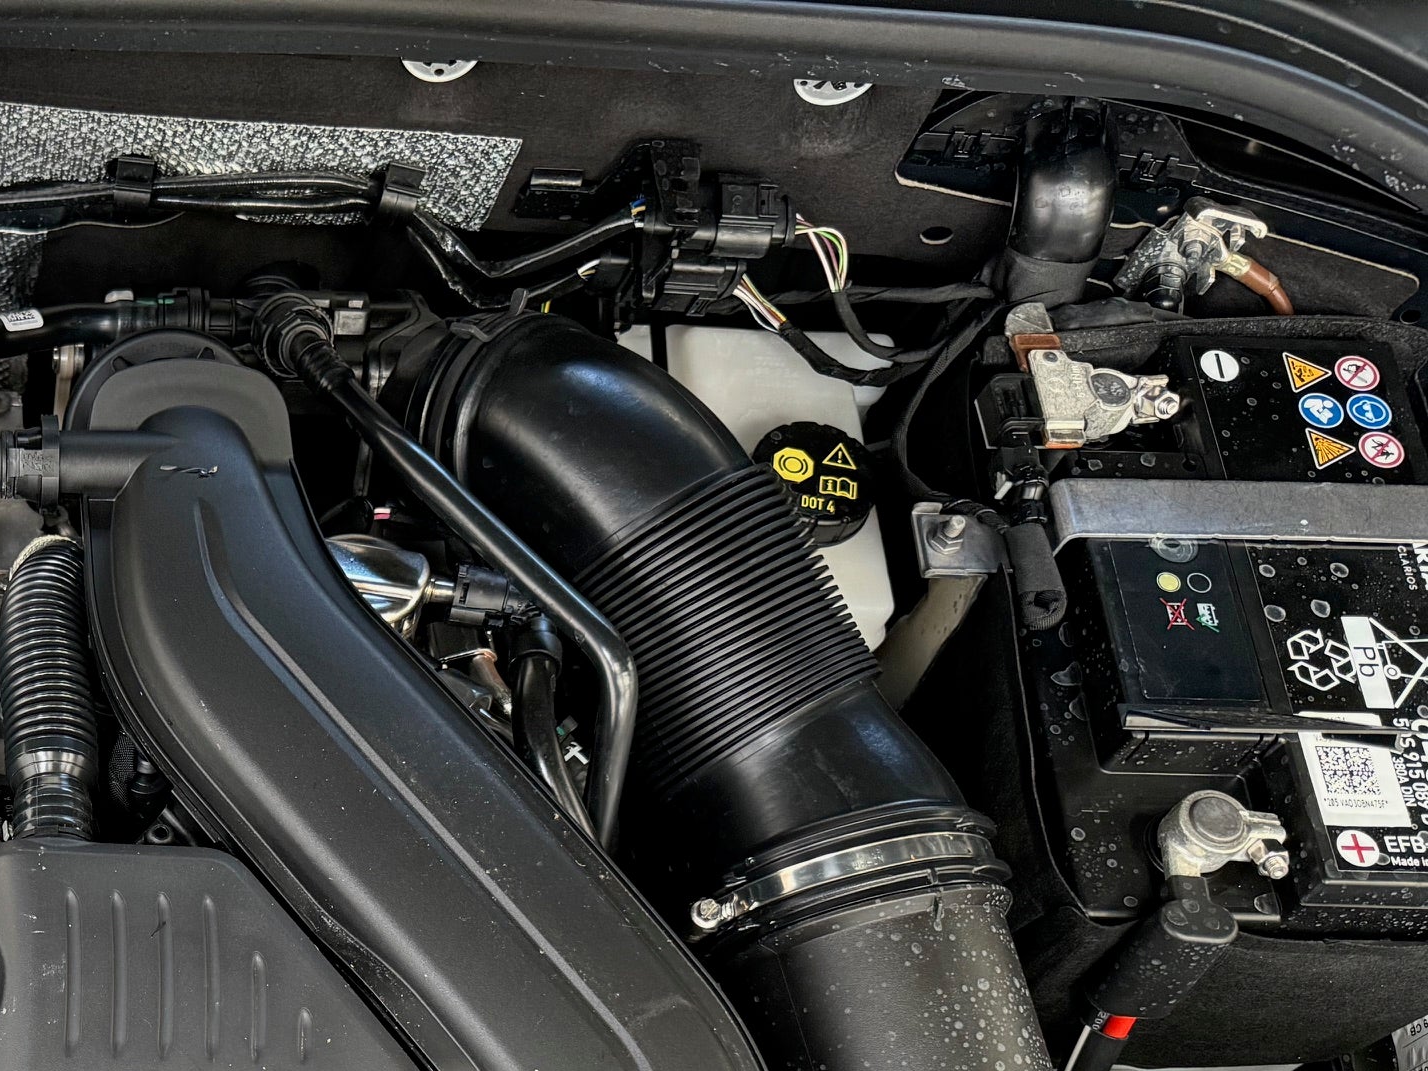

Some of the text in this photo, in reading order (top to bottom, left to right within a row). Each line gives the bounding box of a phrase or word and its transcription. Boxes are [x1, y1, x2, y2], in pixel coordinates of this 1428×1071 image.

[800, 494, 836, 513] DOT 4
[1397, 545, 1418, 590] CLARIOS
[1353, 646, 1379, 678] Pb
[1403, 751, 1425, 780] 915
[1401, 785, 1418, 808] DIN
[1412, 782, 1428, 812] 089
[1391, 856, 1421, 868] Made
